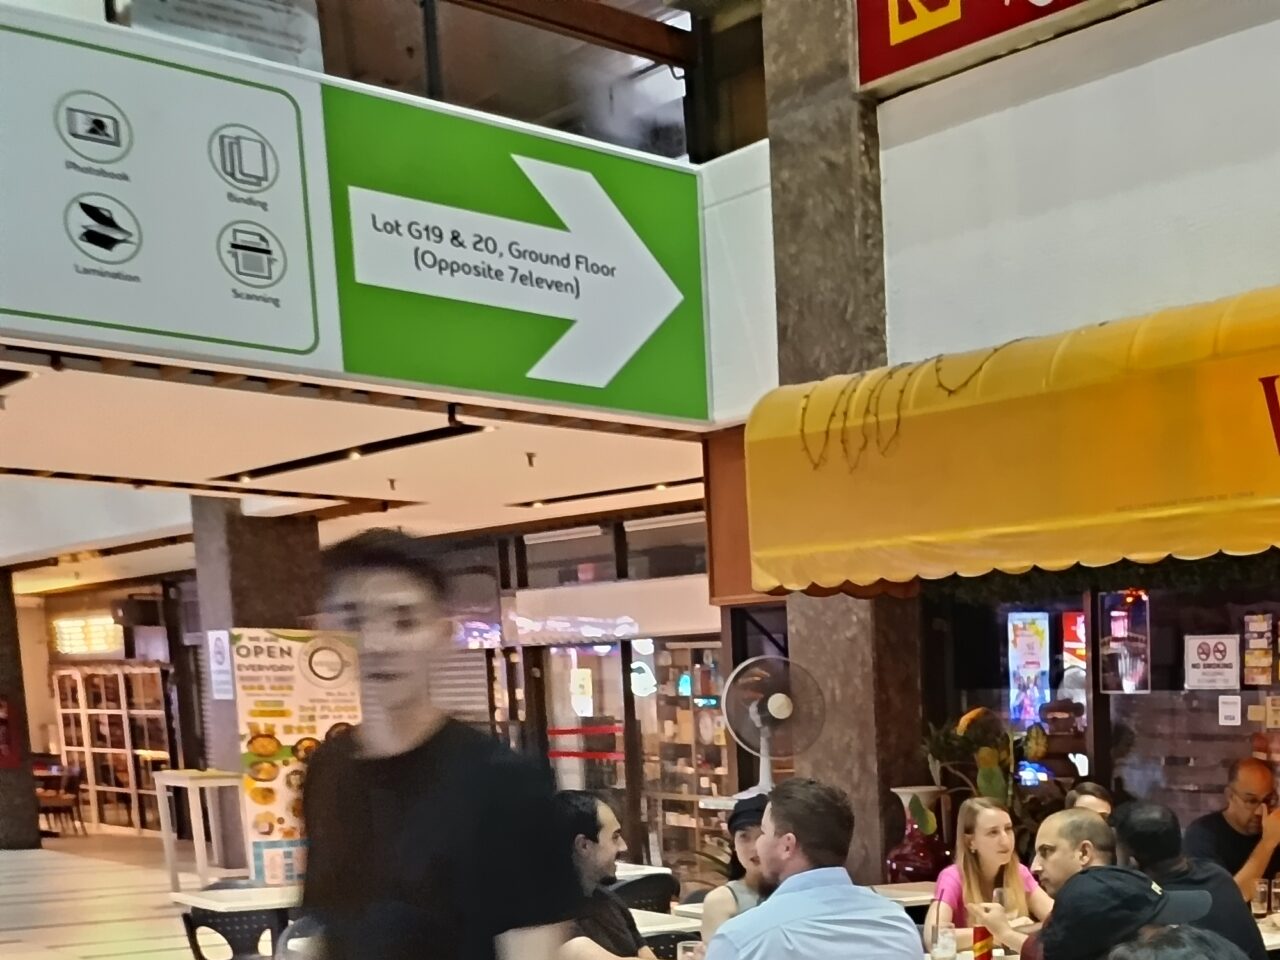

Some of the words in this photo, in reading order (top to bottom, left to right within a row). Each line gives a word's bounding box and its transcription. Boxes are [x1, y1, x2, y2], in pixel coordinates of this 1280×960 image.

[371, 213, 403, 236] Lot
[407, 221, 444, 244] G19
[450, 229, 466, 249] &
[472, 233, 504, 258] 20,
[508, 241, 571, 269] Ground
[575, 254, 617, 277] Floor
[413, 246, 504, 281] (Opposite
[508, 265, 581, 299] 7eleven)
[236, 645, 292, 659] OPEN
